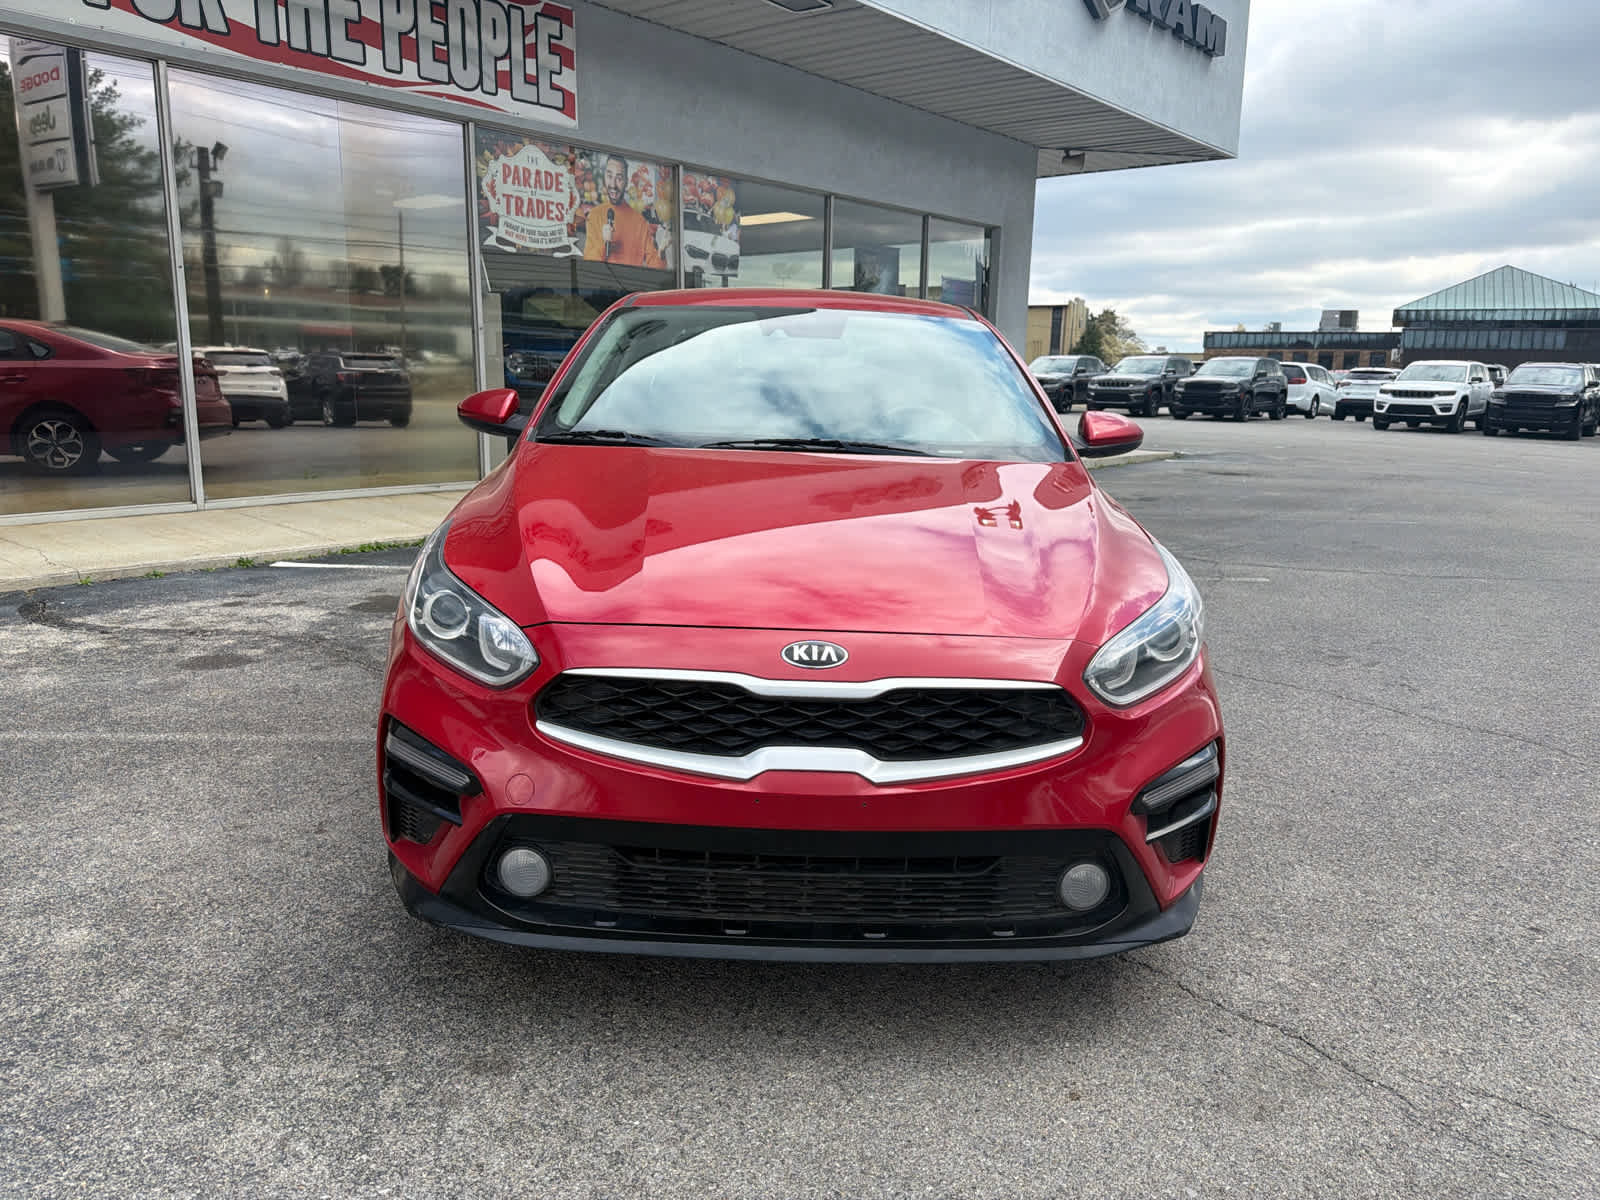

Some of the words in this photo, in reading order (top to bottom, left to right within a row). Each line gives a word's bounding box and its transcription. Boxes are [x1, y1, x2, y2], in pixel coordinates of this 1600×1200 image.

[381, 0, 565, 110] PEOPLE
[502, 163, 564, 192] PARADE
[502, 193, 565, 222] TRADES
[793, 645, 838, 662] KIA
